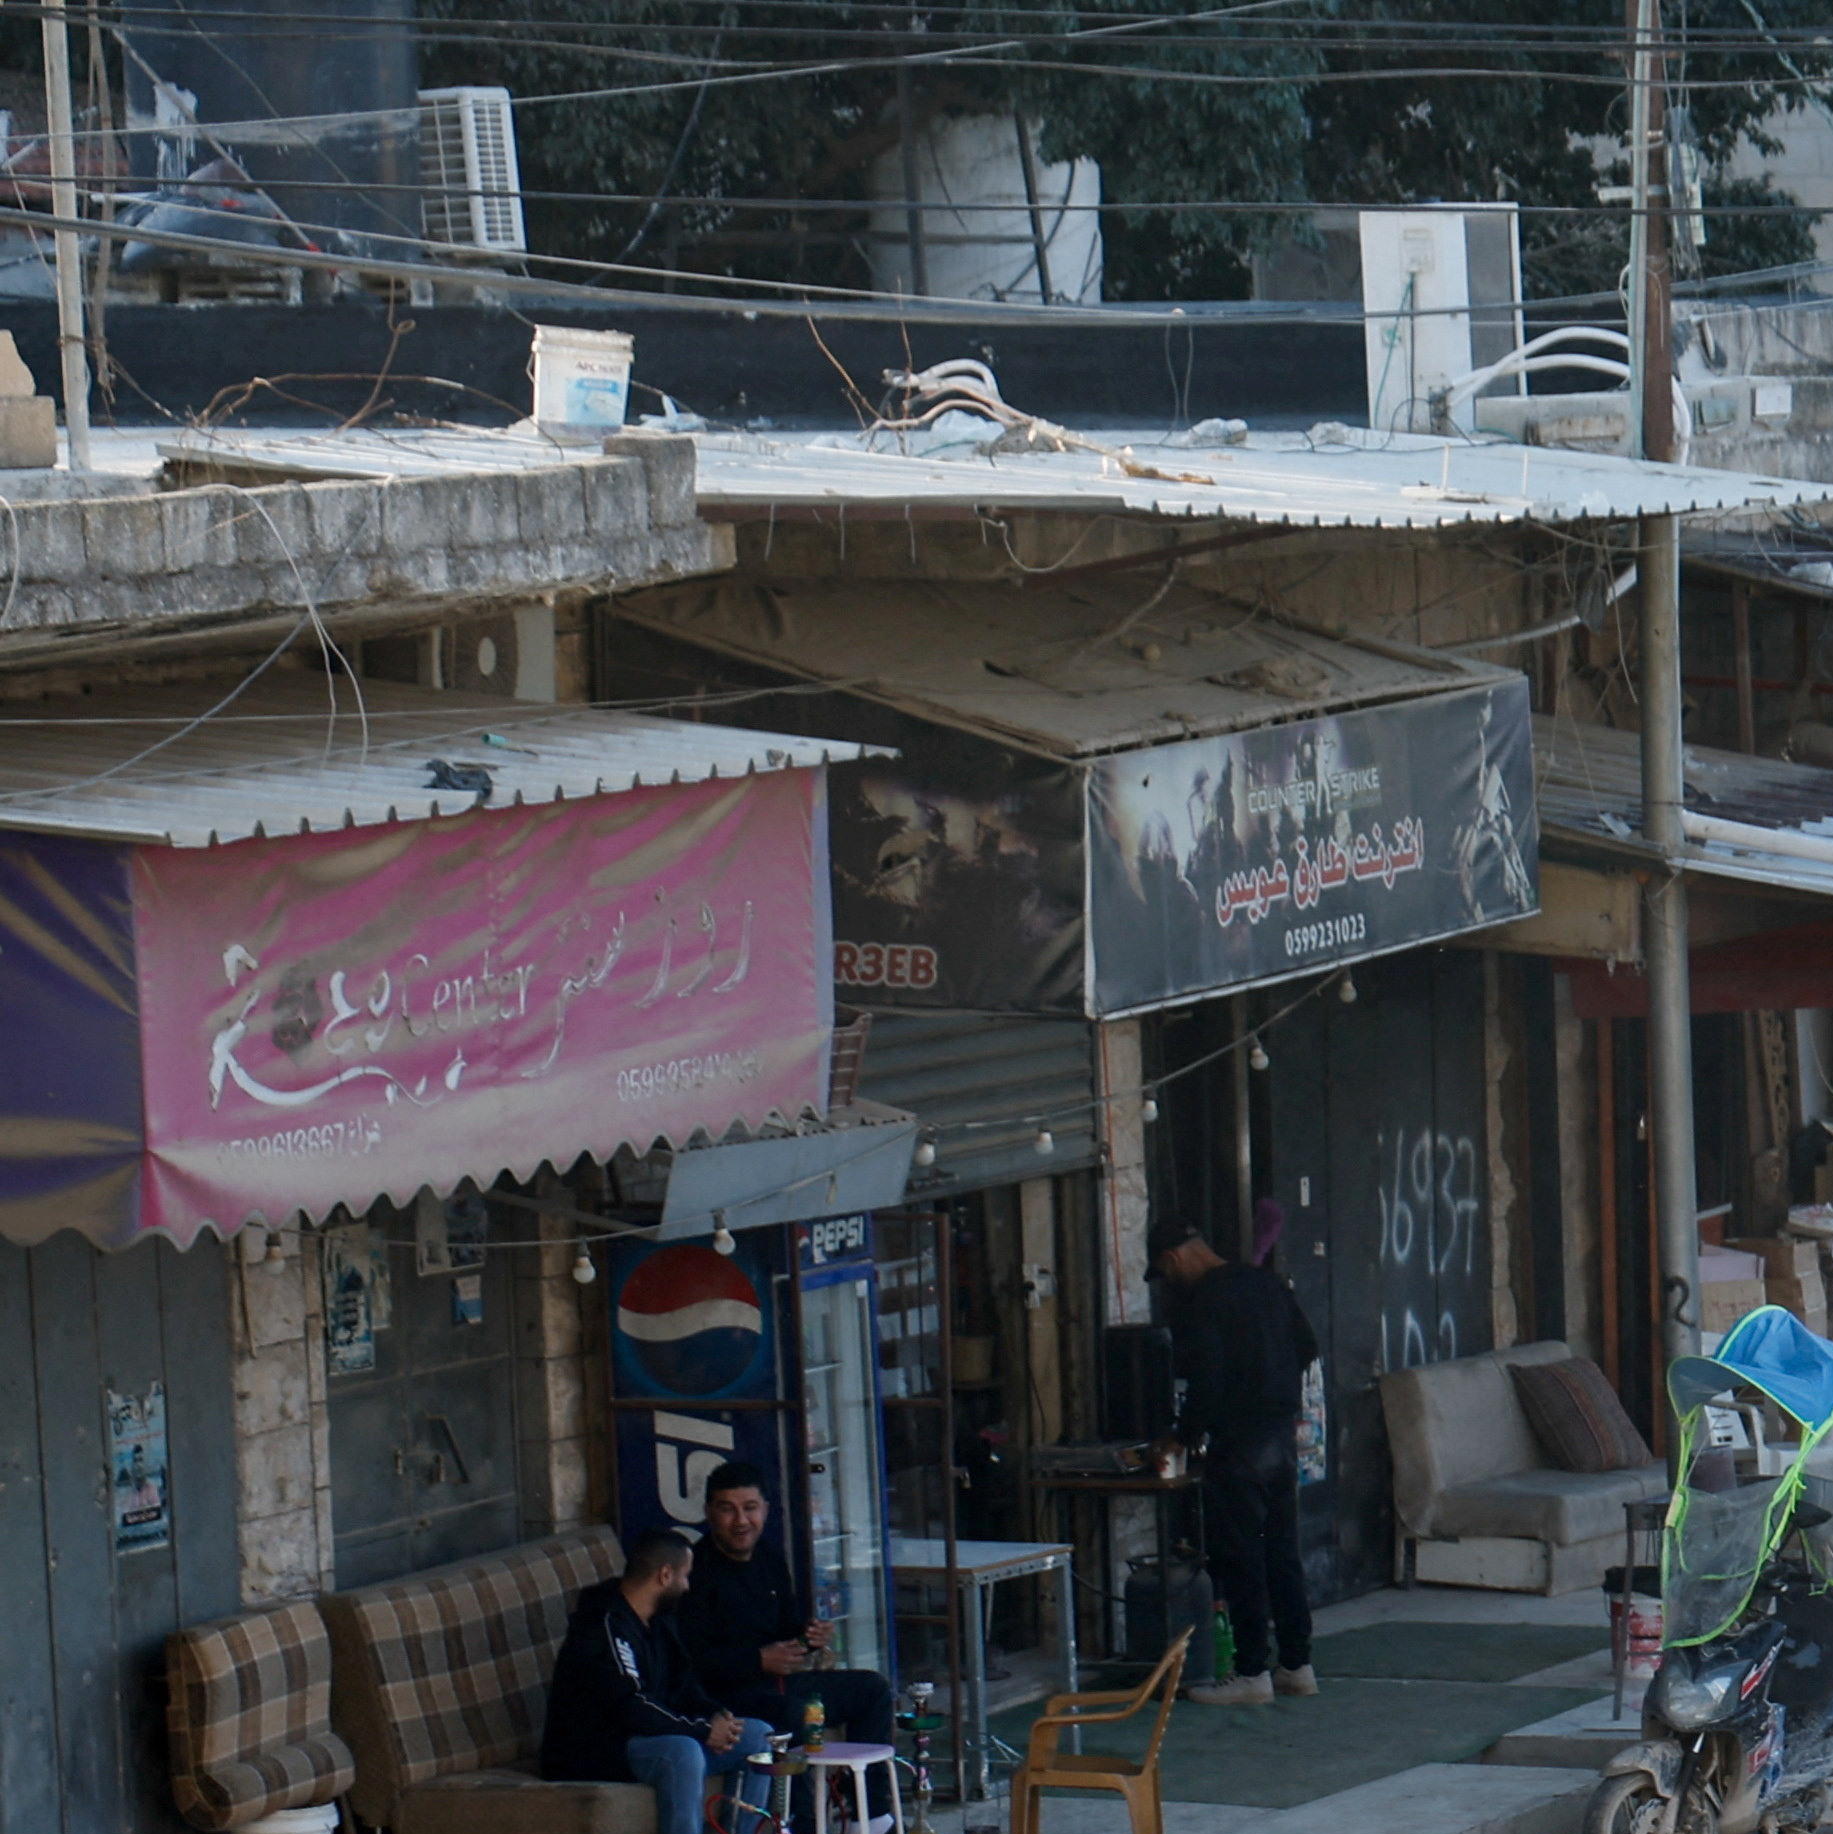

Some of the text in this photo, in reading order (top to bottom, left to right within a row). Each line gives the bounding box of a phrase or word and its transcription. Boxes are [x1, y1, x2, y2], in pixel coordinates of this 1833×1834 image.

[1248, 780, 1316, 815] COUNTER
[1329, 767, 1380, 797] STRIKE
[1215, 857, 1290, 928] عويس
[1294, 834, 1348, 911] طارق
[1285, 912, 1366, 957] 0599231023
[812, 1216, 866, 1265] PEPSI
